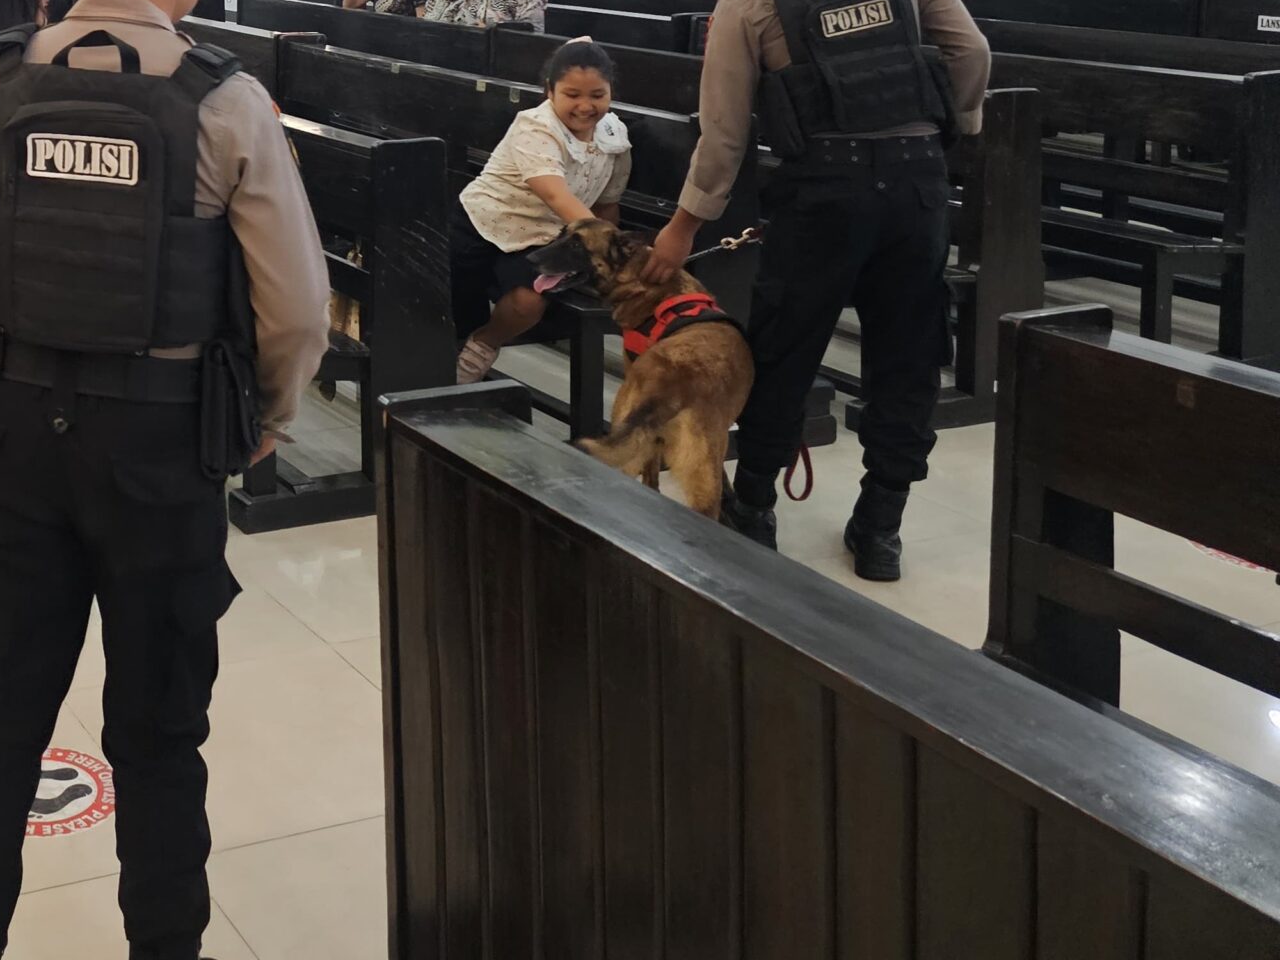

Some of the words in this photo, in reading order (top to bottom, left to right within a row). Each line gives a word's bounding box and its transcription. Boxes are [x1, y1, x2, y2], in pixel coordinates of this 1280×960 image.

[824, 2, 888, 33] POLISI
[34, 139, 131, 178] POLISI
[65, 751, 104, 772] HERE
[41, 809, 105, 835] PLEASE
